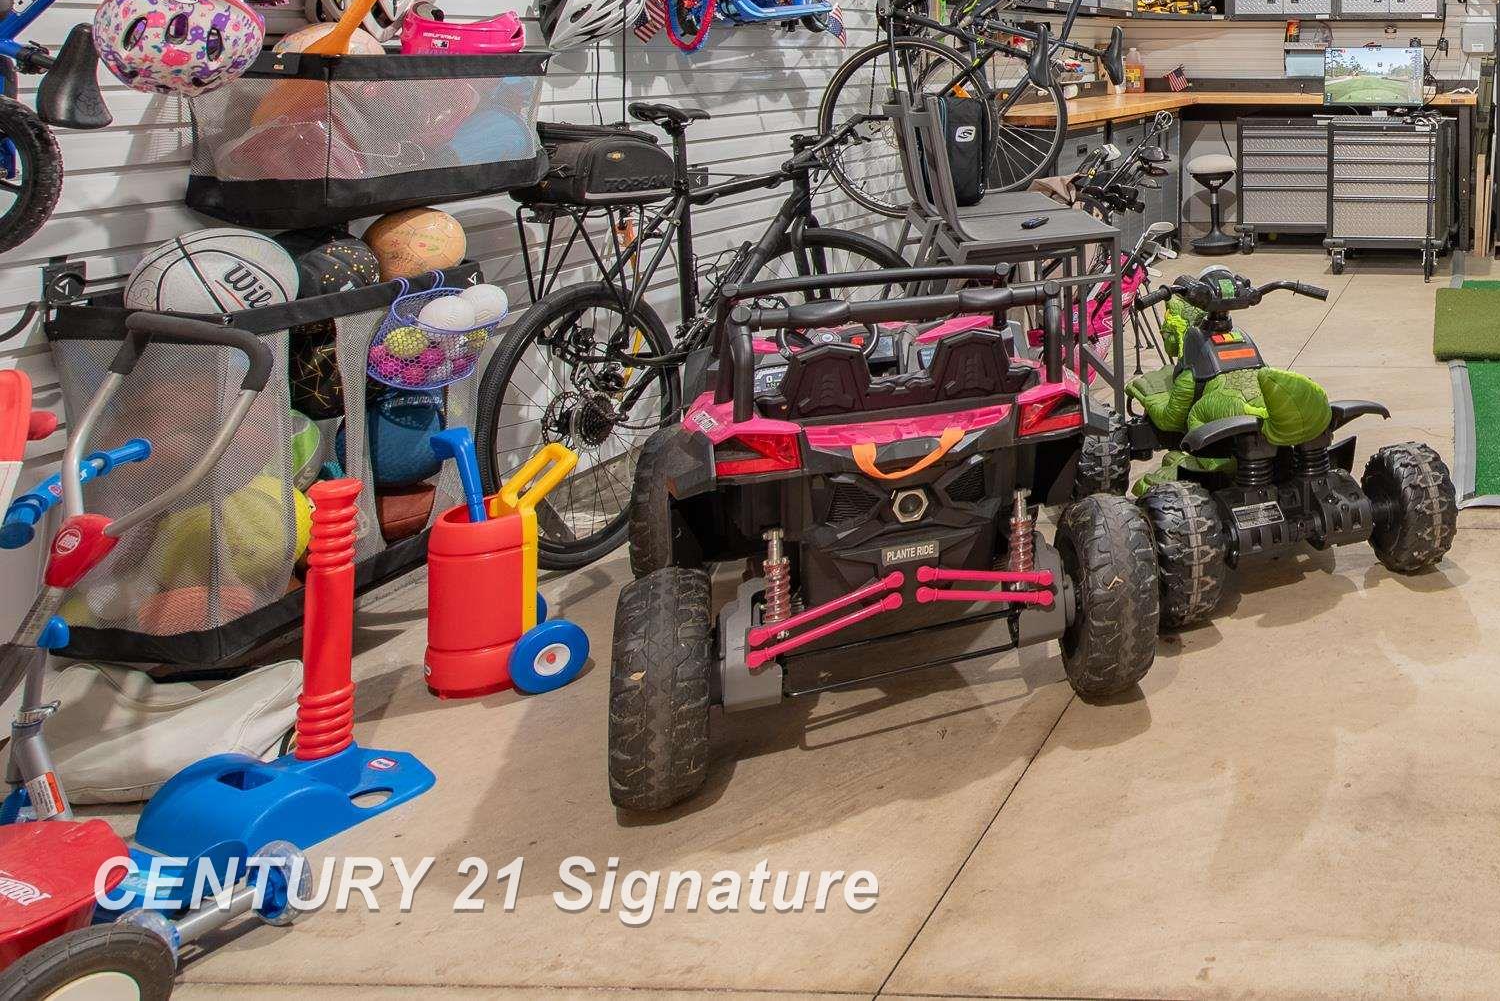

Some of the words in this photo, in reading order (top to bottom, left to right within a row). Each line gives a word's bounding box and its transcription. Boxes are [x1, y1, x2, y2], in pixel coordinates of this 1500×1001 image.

[223, 261, 273, 309] Wil
[886, 547, 916, 562] PLANTE
[916, 543, 935, 556] RIDE
